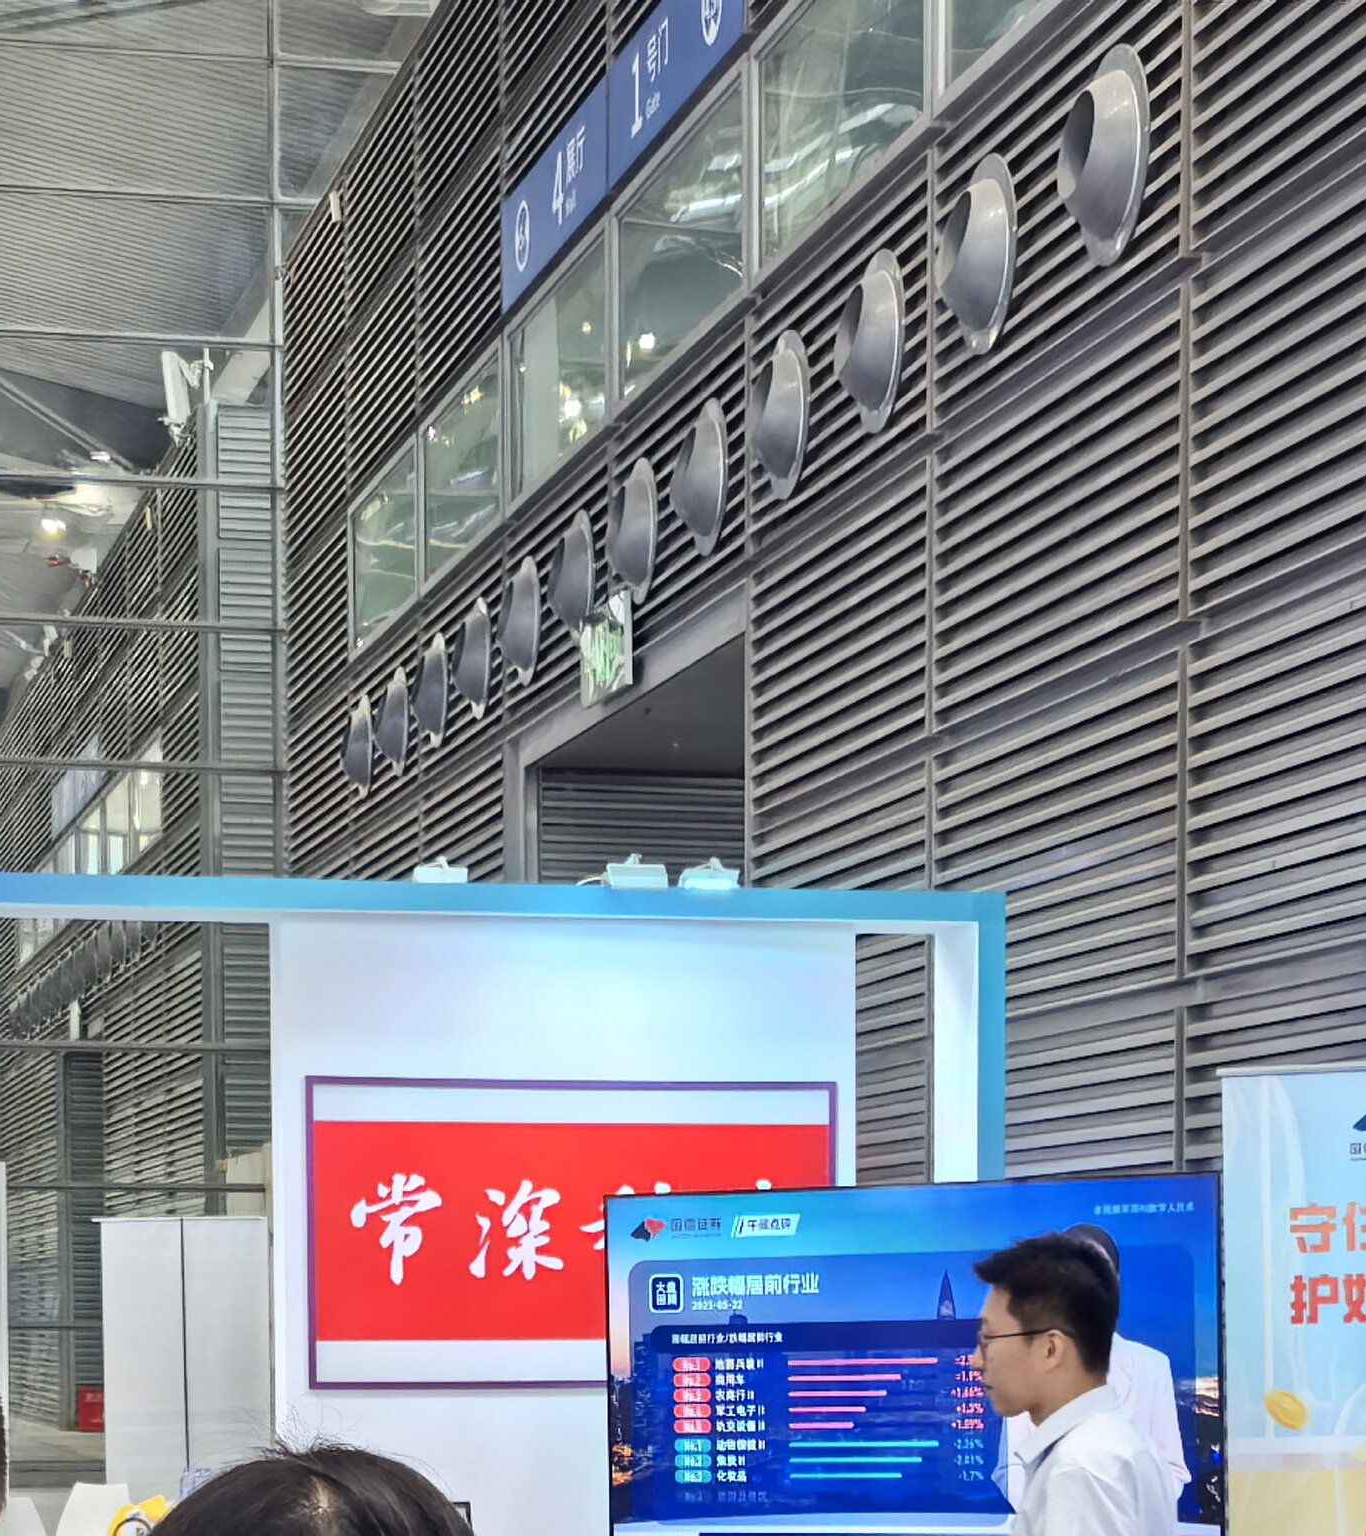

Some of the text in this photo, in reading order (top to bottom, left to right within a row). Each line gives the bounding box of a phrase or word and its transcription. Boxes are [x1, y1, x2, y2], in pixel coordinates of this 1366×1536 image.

[691, 1272, 820, 1297] 涨跌幅居前行业
[716, 1469, 747, 1483] 化妆品
